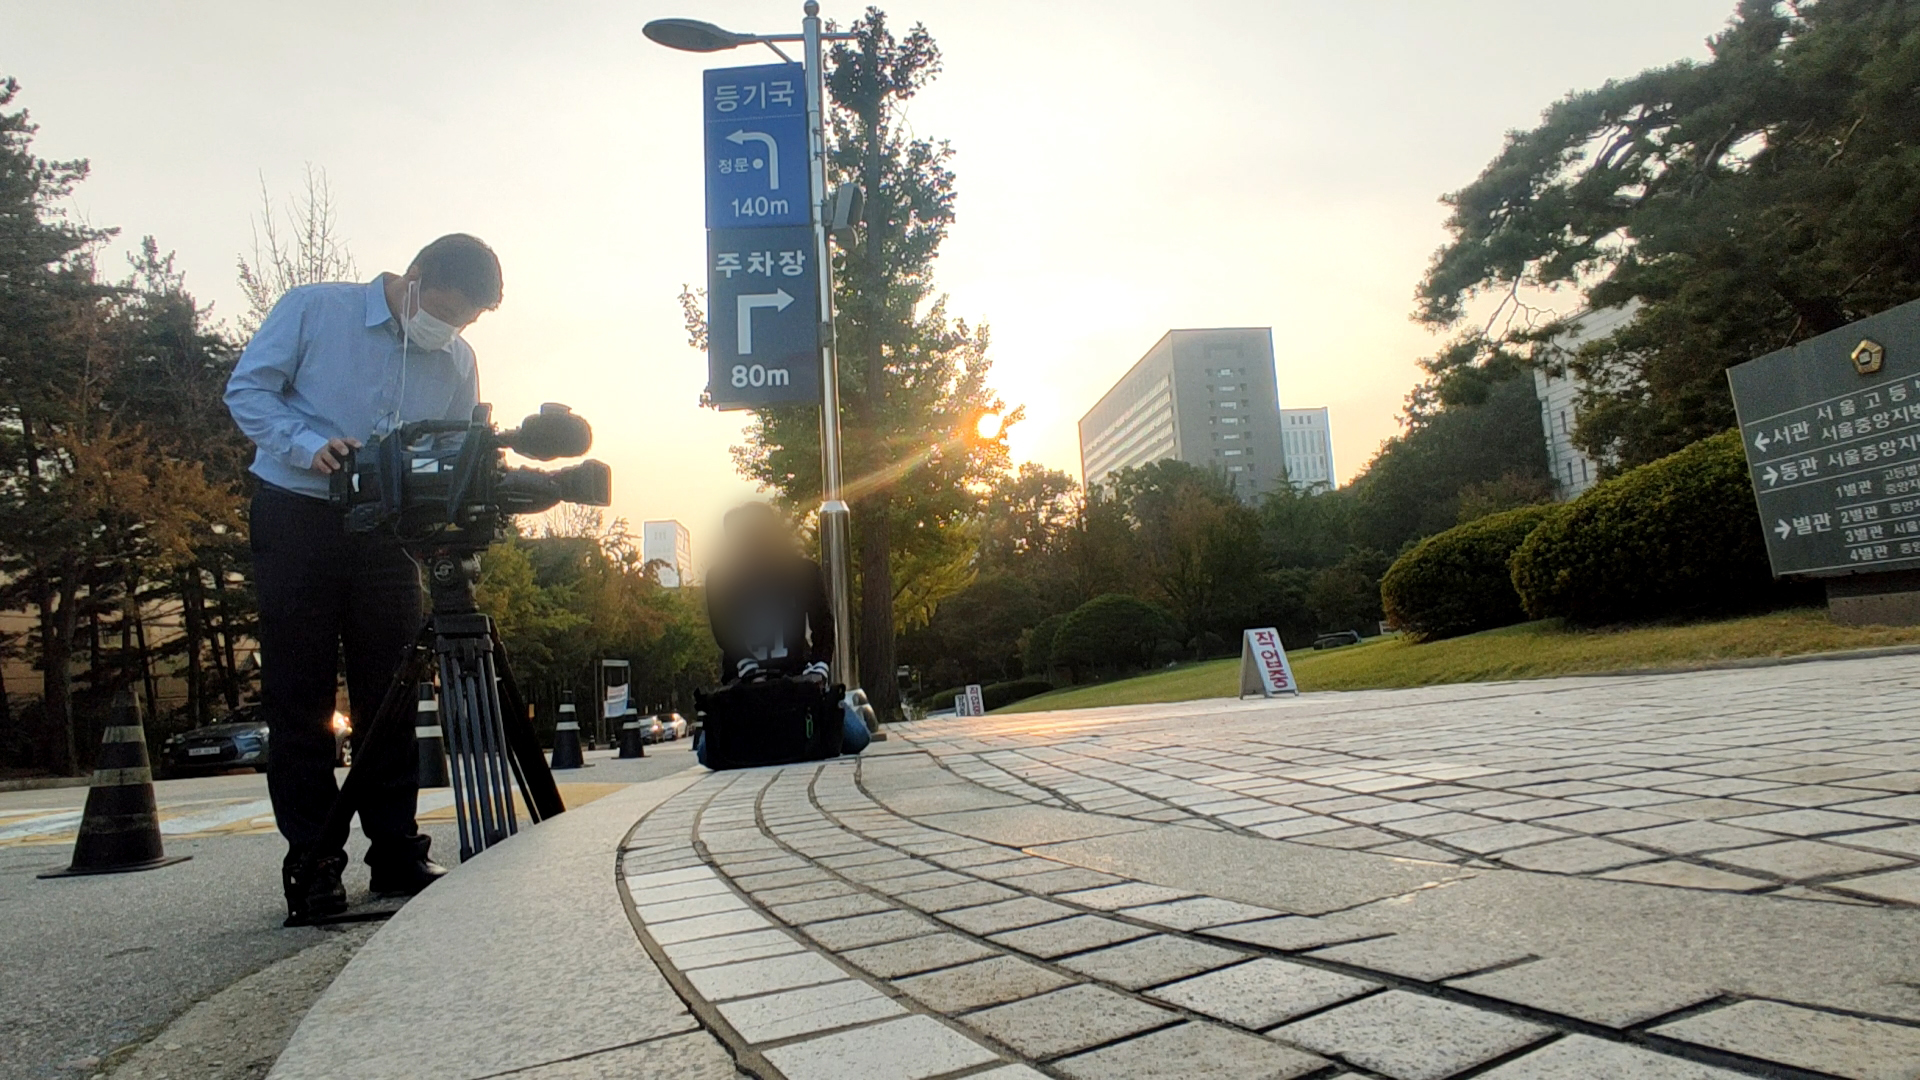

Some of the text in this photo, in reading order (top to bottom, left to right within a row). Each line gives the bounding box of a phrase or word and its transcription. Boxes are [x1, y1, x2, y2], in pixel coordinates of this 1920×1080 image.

[714, 80, 795, 112] 등기국
[718, 157, 749, 174] 정문
[731, 196, 789, 218] 140m
[715, 250, 806, 279] 주차장
[731, 364, 790, 388] 80m
[1773, 420, 1811, 445] 서관
[1780, 433, 1920, 481] 동관 서울중앙지
[1835, 480, 1873, 498] 1별관
[1792, 512, 1833, 536] 별관
[1840, 505, 1880, 524] 2별관
[1844, 525, 1884, 543] 3별관
[1849, 544, 1889, 561] 4별관
[1254, 631, 1289, 689] 작업중
